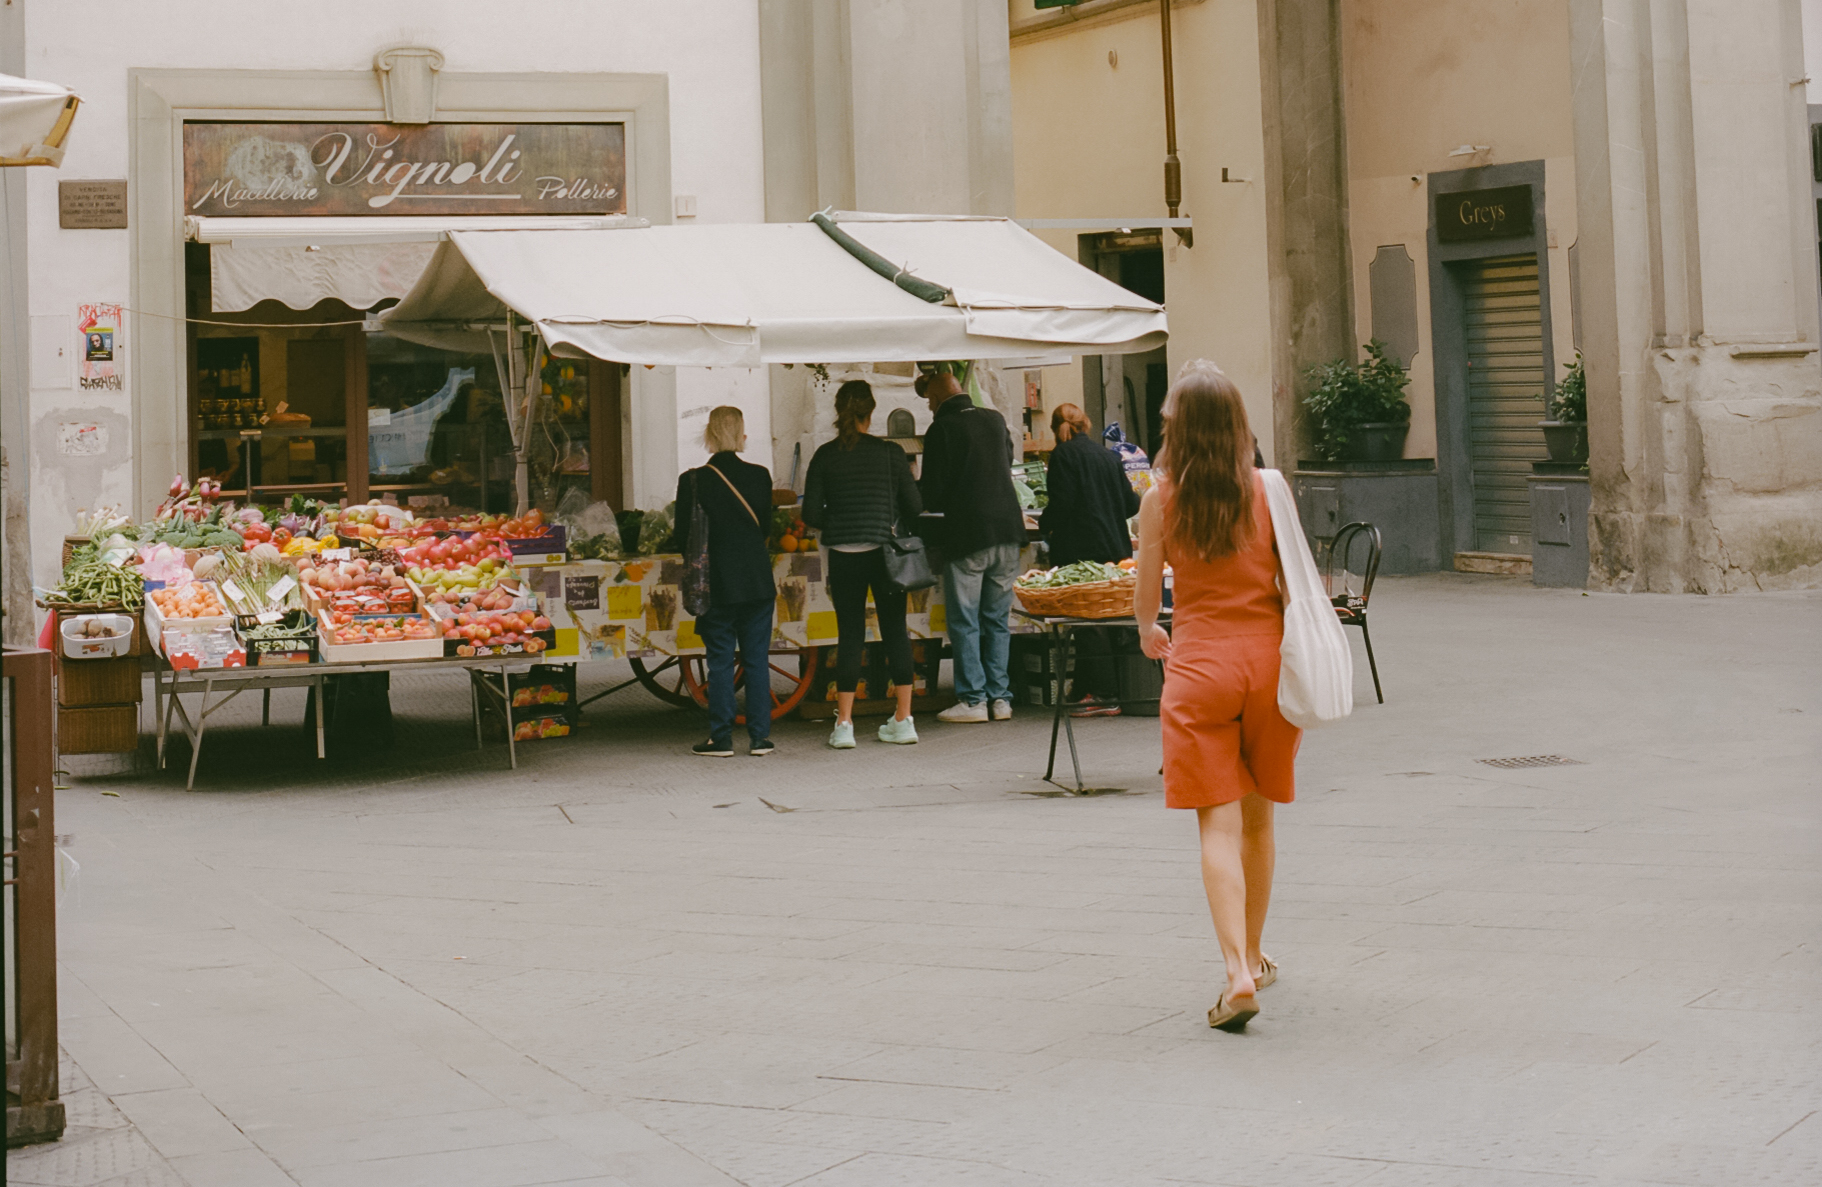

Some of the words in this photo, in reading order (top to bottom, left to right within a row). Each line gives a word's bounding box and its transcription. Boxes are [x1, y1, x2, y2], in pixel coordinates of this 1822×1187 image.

[310, 131, 523, 209] Vignoli
[193, 178, 319, 209] Macellerie
[535, 176, 619, 201] Pollerie
[1459, 200, 1505, 231] Greys
